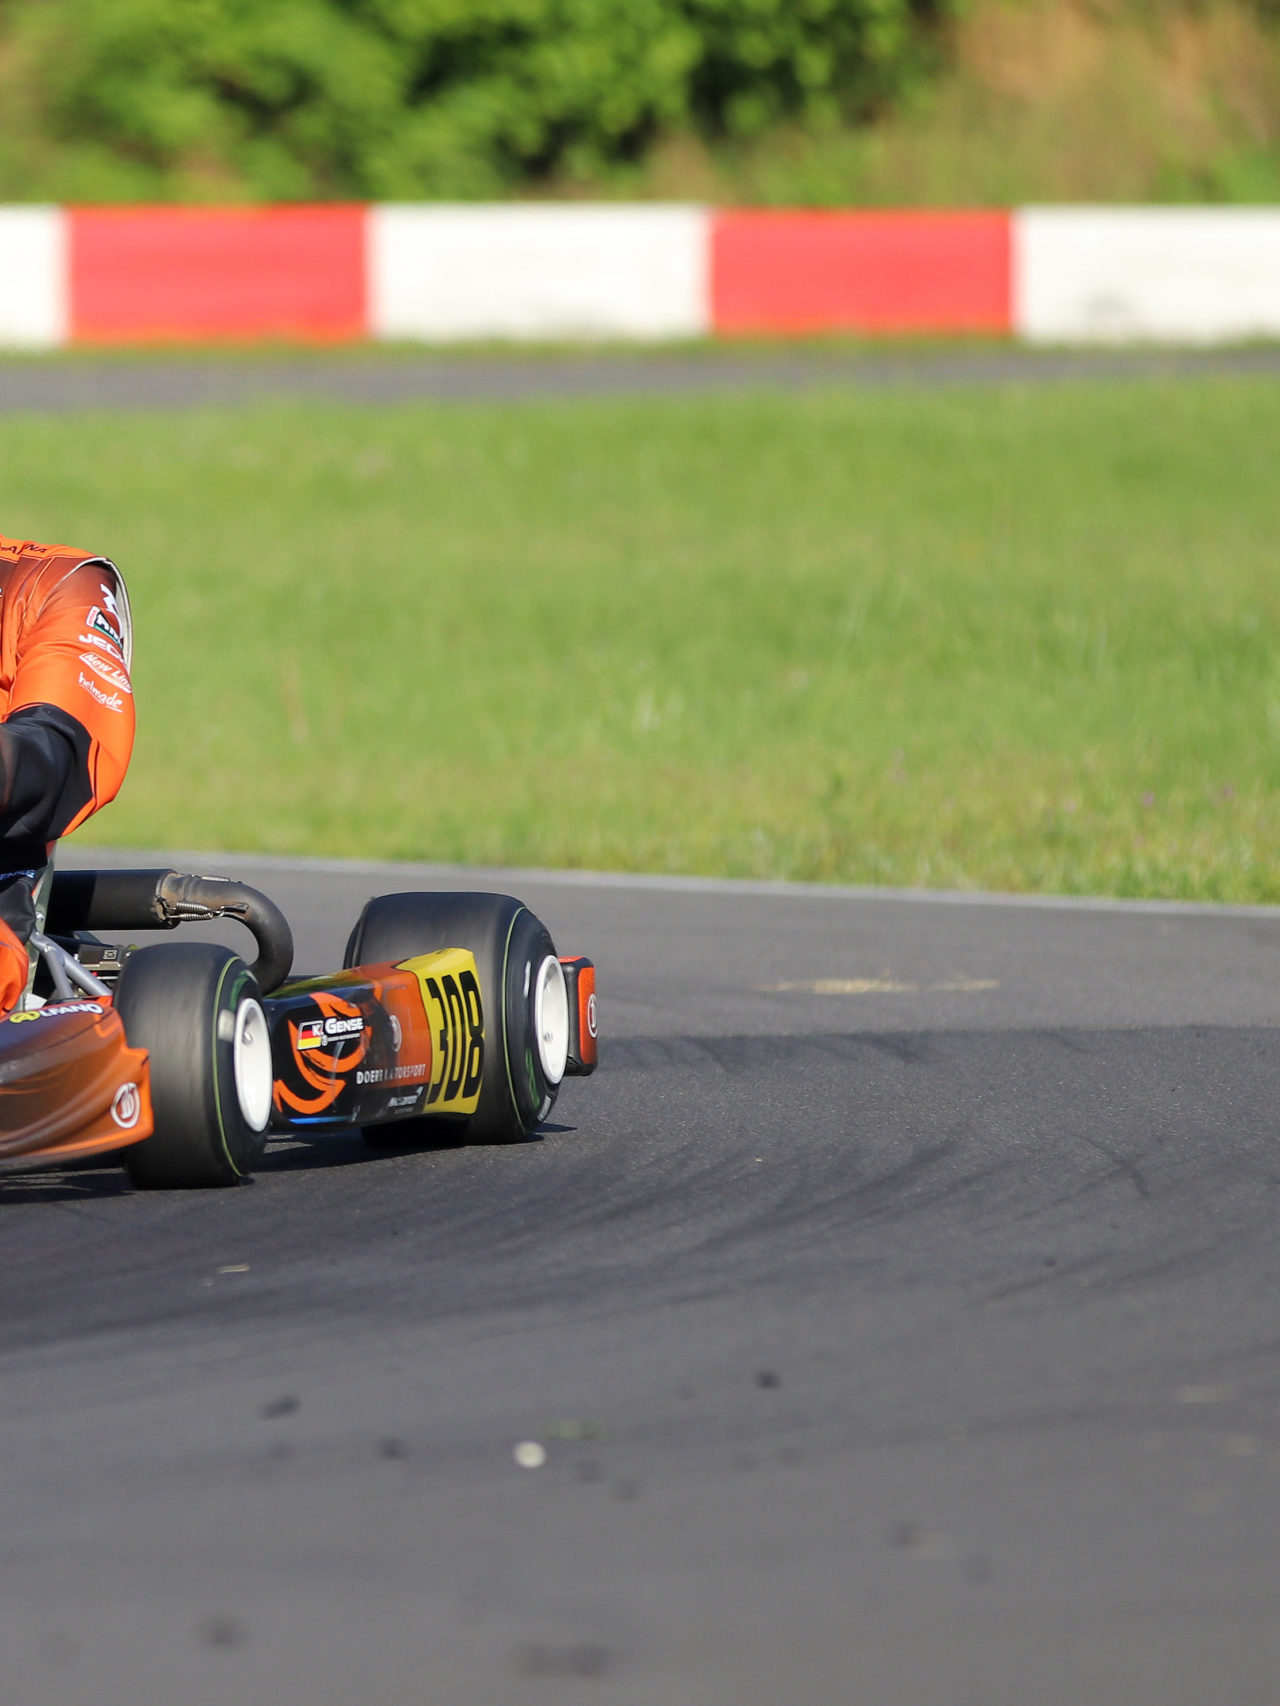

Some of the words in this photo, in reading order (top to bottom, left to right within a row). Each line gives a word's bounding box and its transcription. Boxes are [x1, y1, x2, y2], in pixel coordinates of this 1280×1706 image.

[78, 671, 123, 709] helmade
[8, 1002, 105, 1023] ALFANO
[424, 970, 485, 1105] 308
[385, 1064, 426, 1081] TORSPORT
